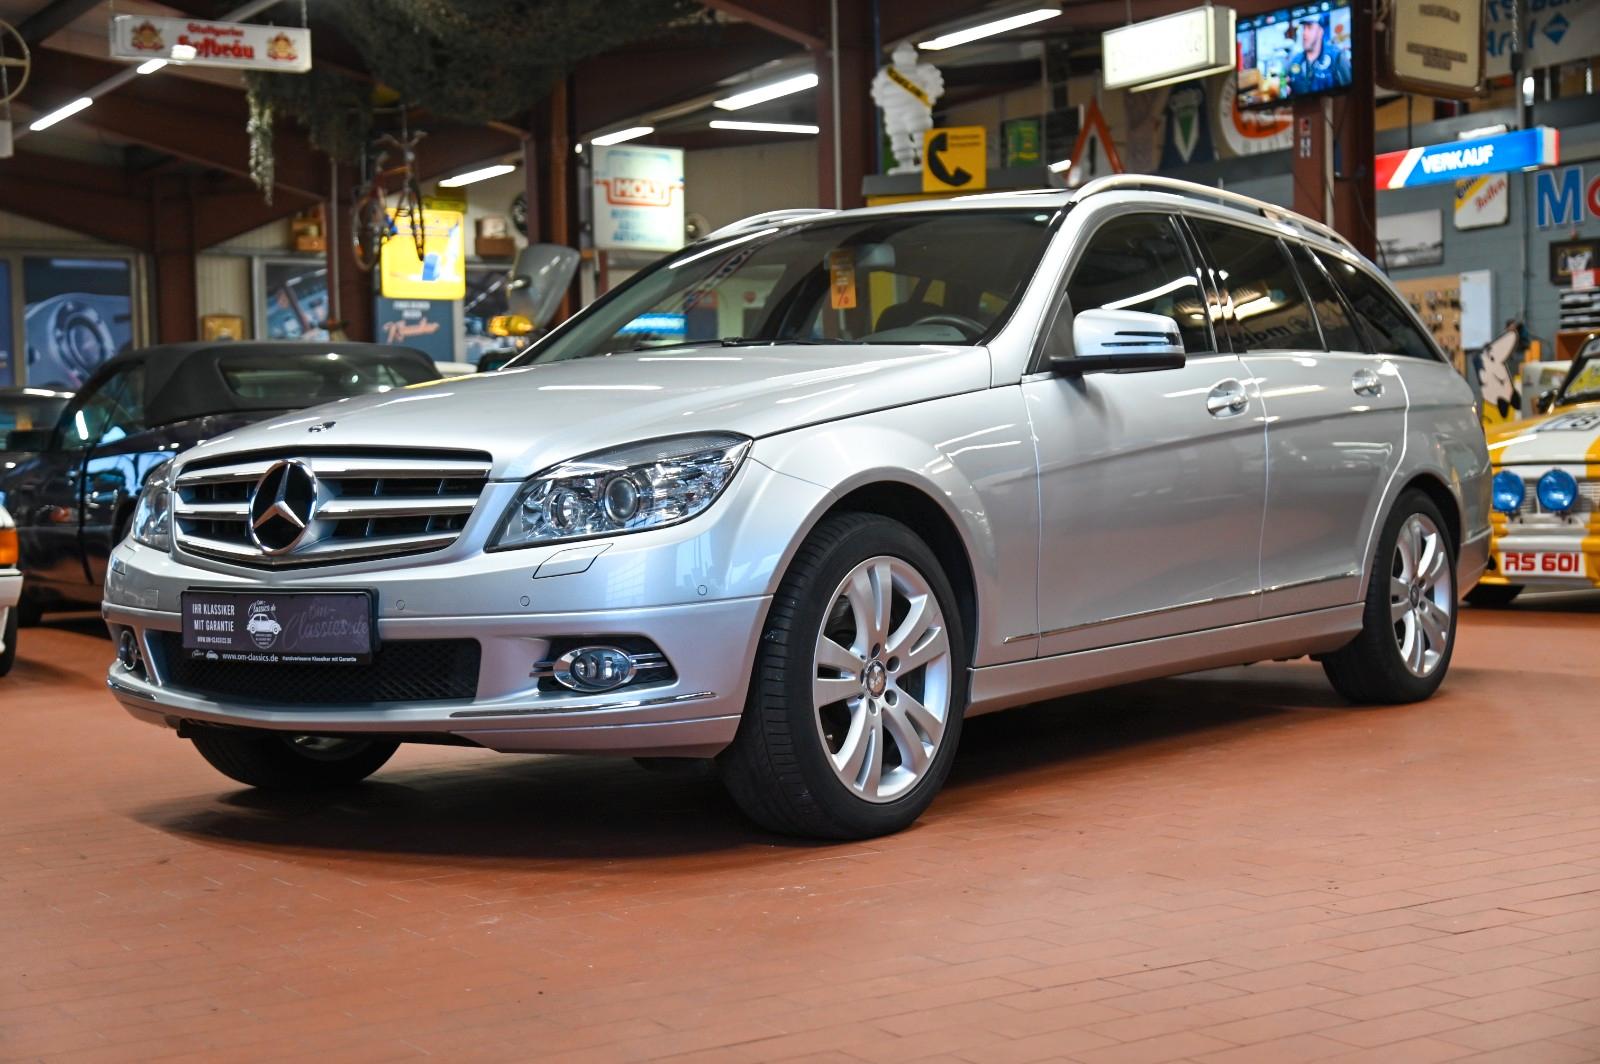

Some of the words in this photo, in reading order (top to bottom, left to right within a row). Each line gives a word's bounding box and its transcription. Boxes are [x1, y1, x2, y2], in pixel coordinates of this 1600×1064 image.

[1421, 145, 1494, 173] VERKAUF
[1505, 552, 1535, 572] RS
[1541, 552, 1579, 572] 601
[192, 603, 202, 614] IHR
[203, 604, 235, 616] KLASSIKER
[194, 619, 204, 631] MIT
[205, 620, 234, 632] GARANTIE
[222, 653, 279, 662] www.om-classics.de
